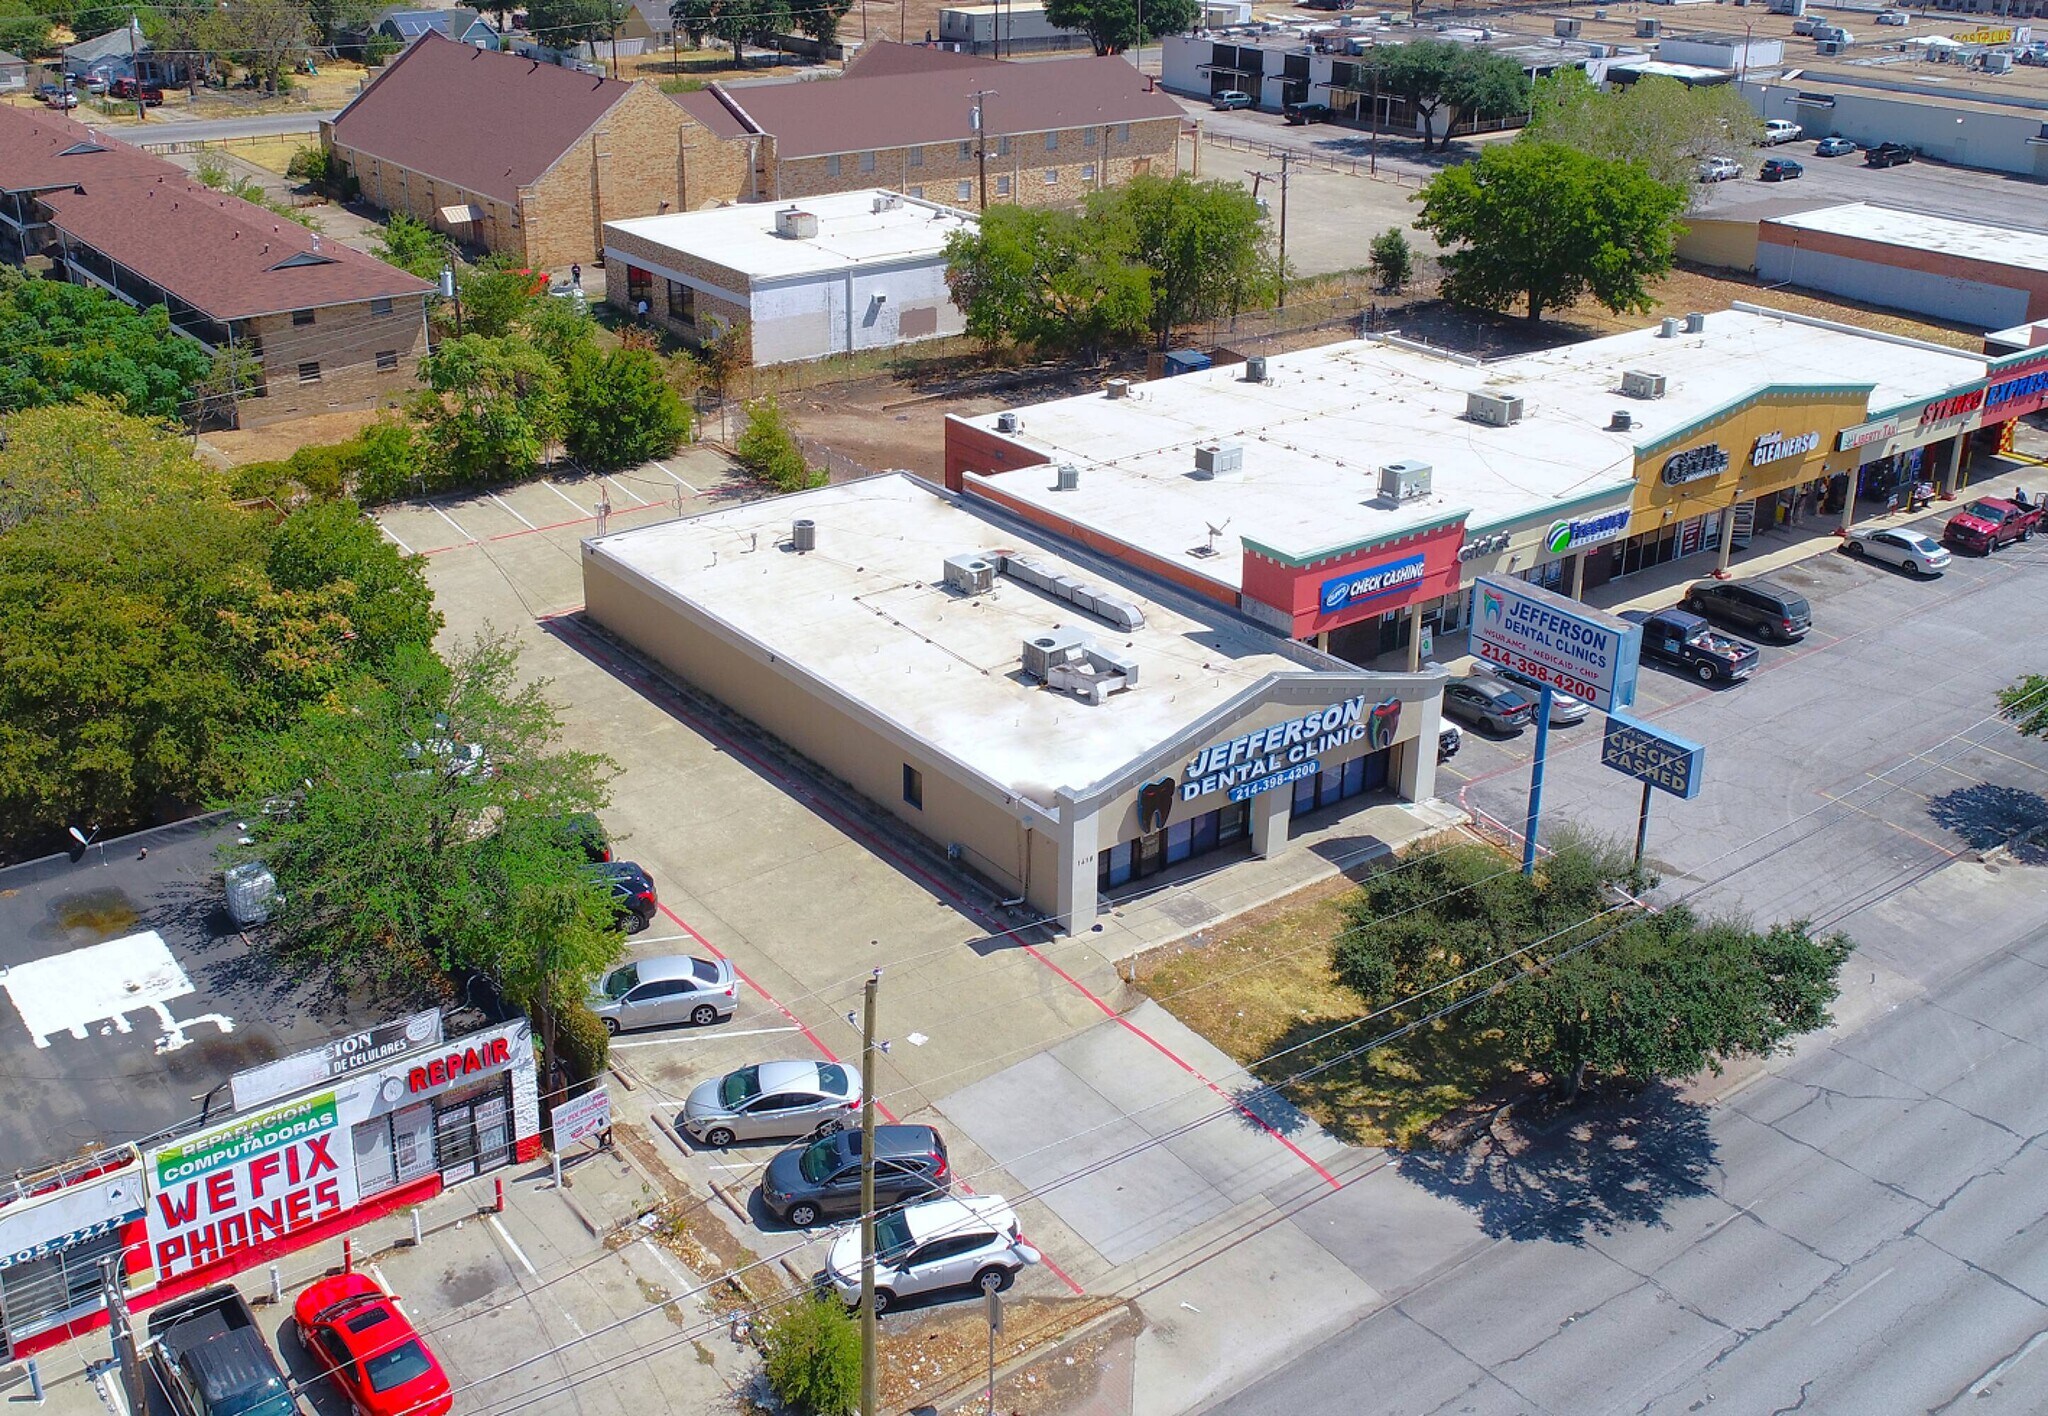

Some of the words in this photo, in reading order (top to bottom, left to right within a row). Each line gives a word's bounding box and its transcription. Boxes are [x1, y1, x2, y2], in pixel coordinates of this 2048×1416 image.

[1920, 389, 1983, 425] STEREO
[1752, 433, 1809, 467] CLEANERS
[1350, 574, 1382, 597] CHECK
[1382, 562, 1425, 588] CASHING
[1504, 618, 1552, 647] DENTAL
[1556, 639, 1607, 668] CLINICS
[1510, 602, 1607, 651] JEFFERSON
[1480, 642, 1597, 702] 214-398-4200
[1484, 627, 1526, 651] INSURANCE
[1533, 649, 1573, 670] MEDICAID
[1580, 667, 1599, 680] CHIP
[1187, 695, 1365, 778] JEFFERSON
[1609, 733, 1687, 776] CHECKS
[1181, 752, 1283, 802] DENTAL
[1286, 723, 1367, 764] CLINIC
[1235, 762, 1317, 802] 214-398-4200
[1606, 749, 1687, 791] CASHED
[333, 1058, 349, 1074] DE
[349, 1038, 408, 1068] CELULARES
[409, 1037, 511, 1093] REPAIR
[163, 1112, 334, 1182] COMPUTADORAS
[180, 1102, 313, 1159] REPARACION
[156, 1168, 238, 1230] WE
[248, 1132, 340, 1200] FIX
[156, 1176, 342, 1281] PHONES
